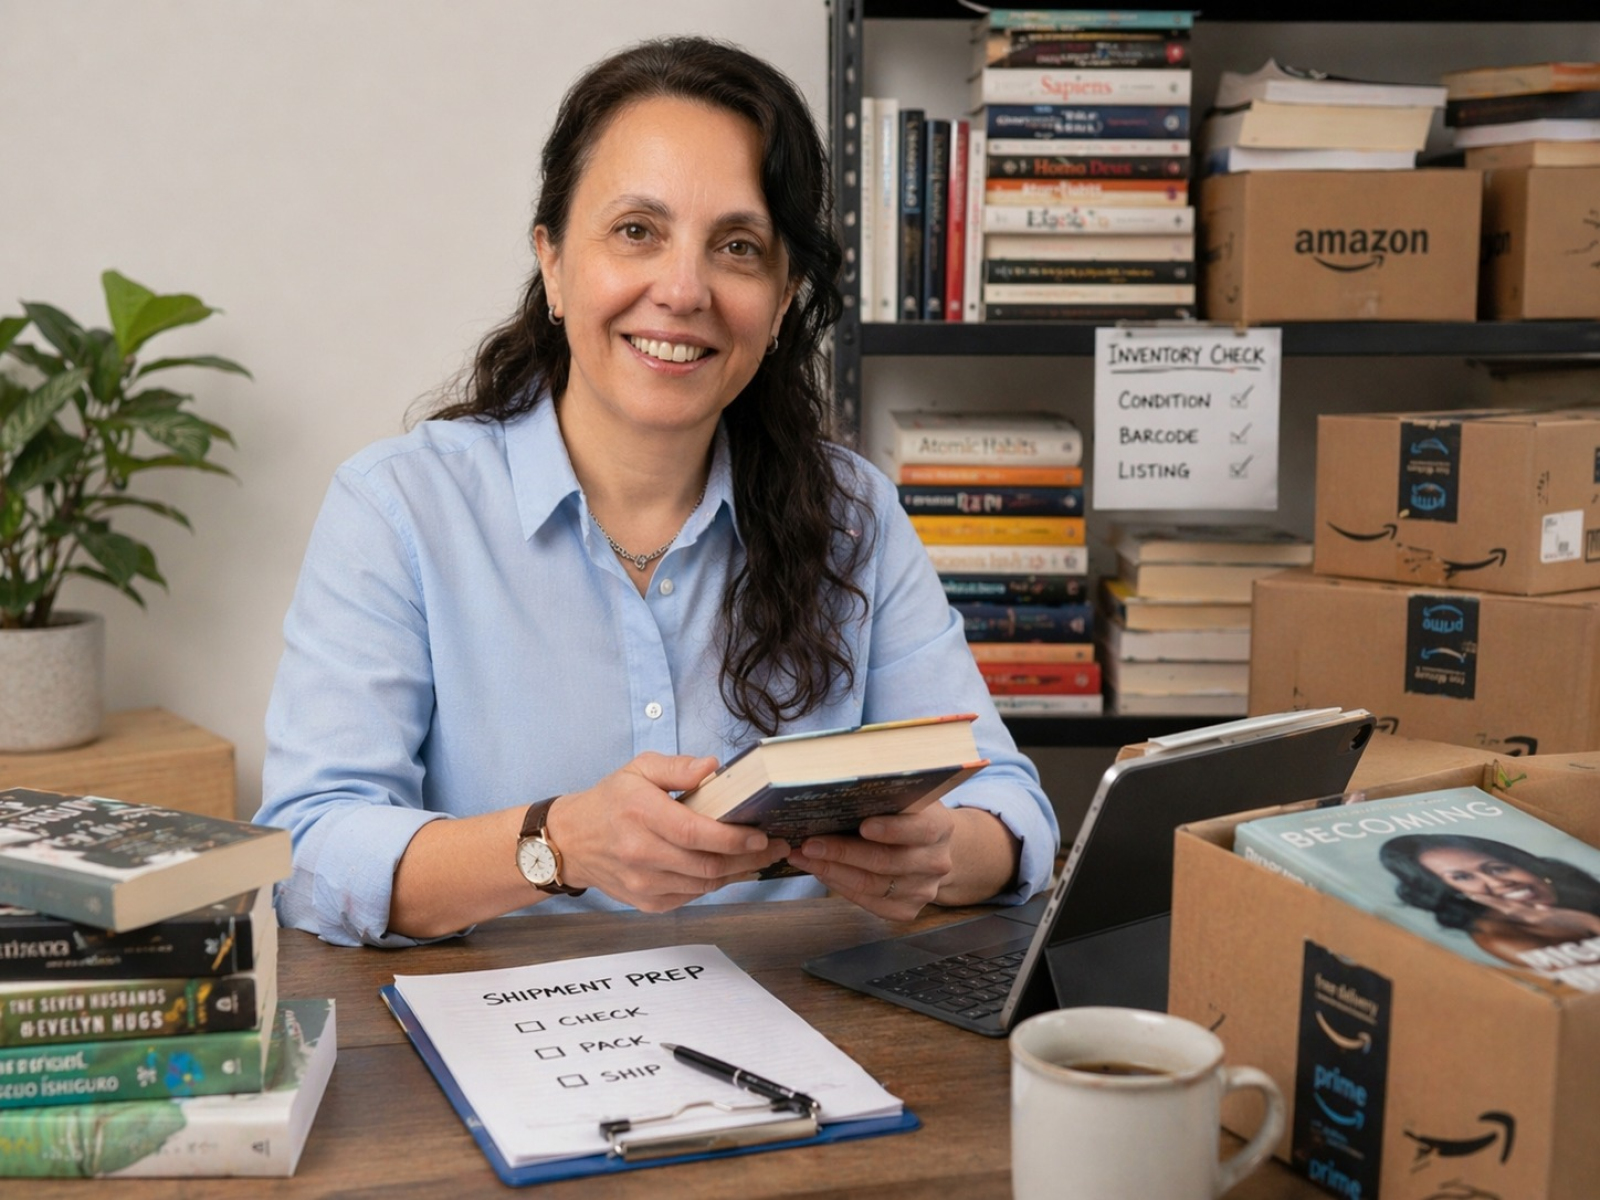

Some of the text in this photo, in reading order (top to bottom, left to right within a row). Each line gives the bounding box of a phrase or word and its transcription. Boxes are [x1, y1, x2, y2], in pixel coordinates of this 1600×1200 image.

[1041, 75, 1113, 101] Sapiens
[1034, 158, 1087, 175] Homo
[1294, 228, 1429, 255] amazon
[1279, 800, 1503, 850] BECOMING
[483, 965, 705, 1006] SHIPMENT PREP
[40, 994, 85, 1013] SEVEN
[89, 988, 166, 1010] HUSBANDS
[558, 1006, 649, 1027] CHECK
[579, 1034, 650, 1053] PACK
[600, 1064, 661, 1083] SHIP
[1314, 1064, 1367, 1107] prime
[1308, 1157, 1362, 1200] prime
